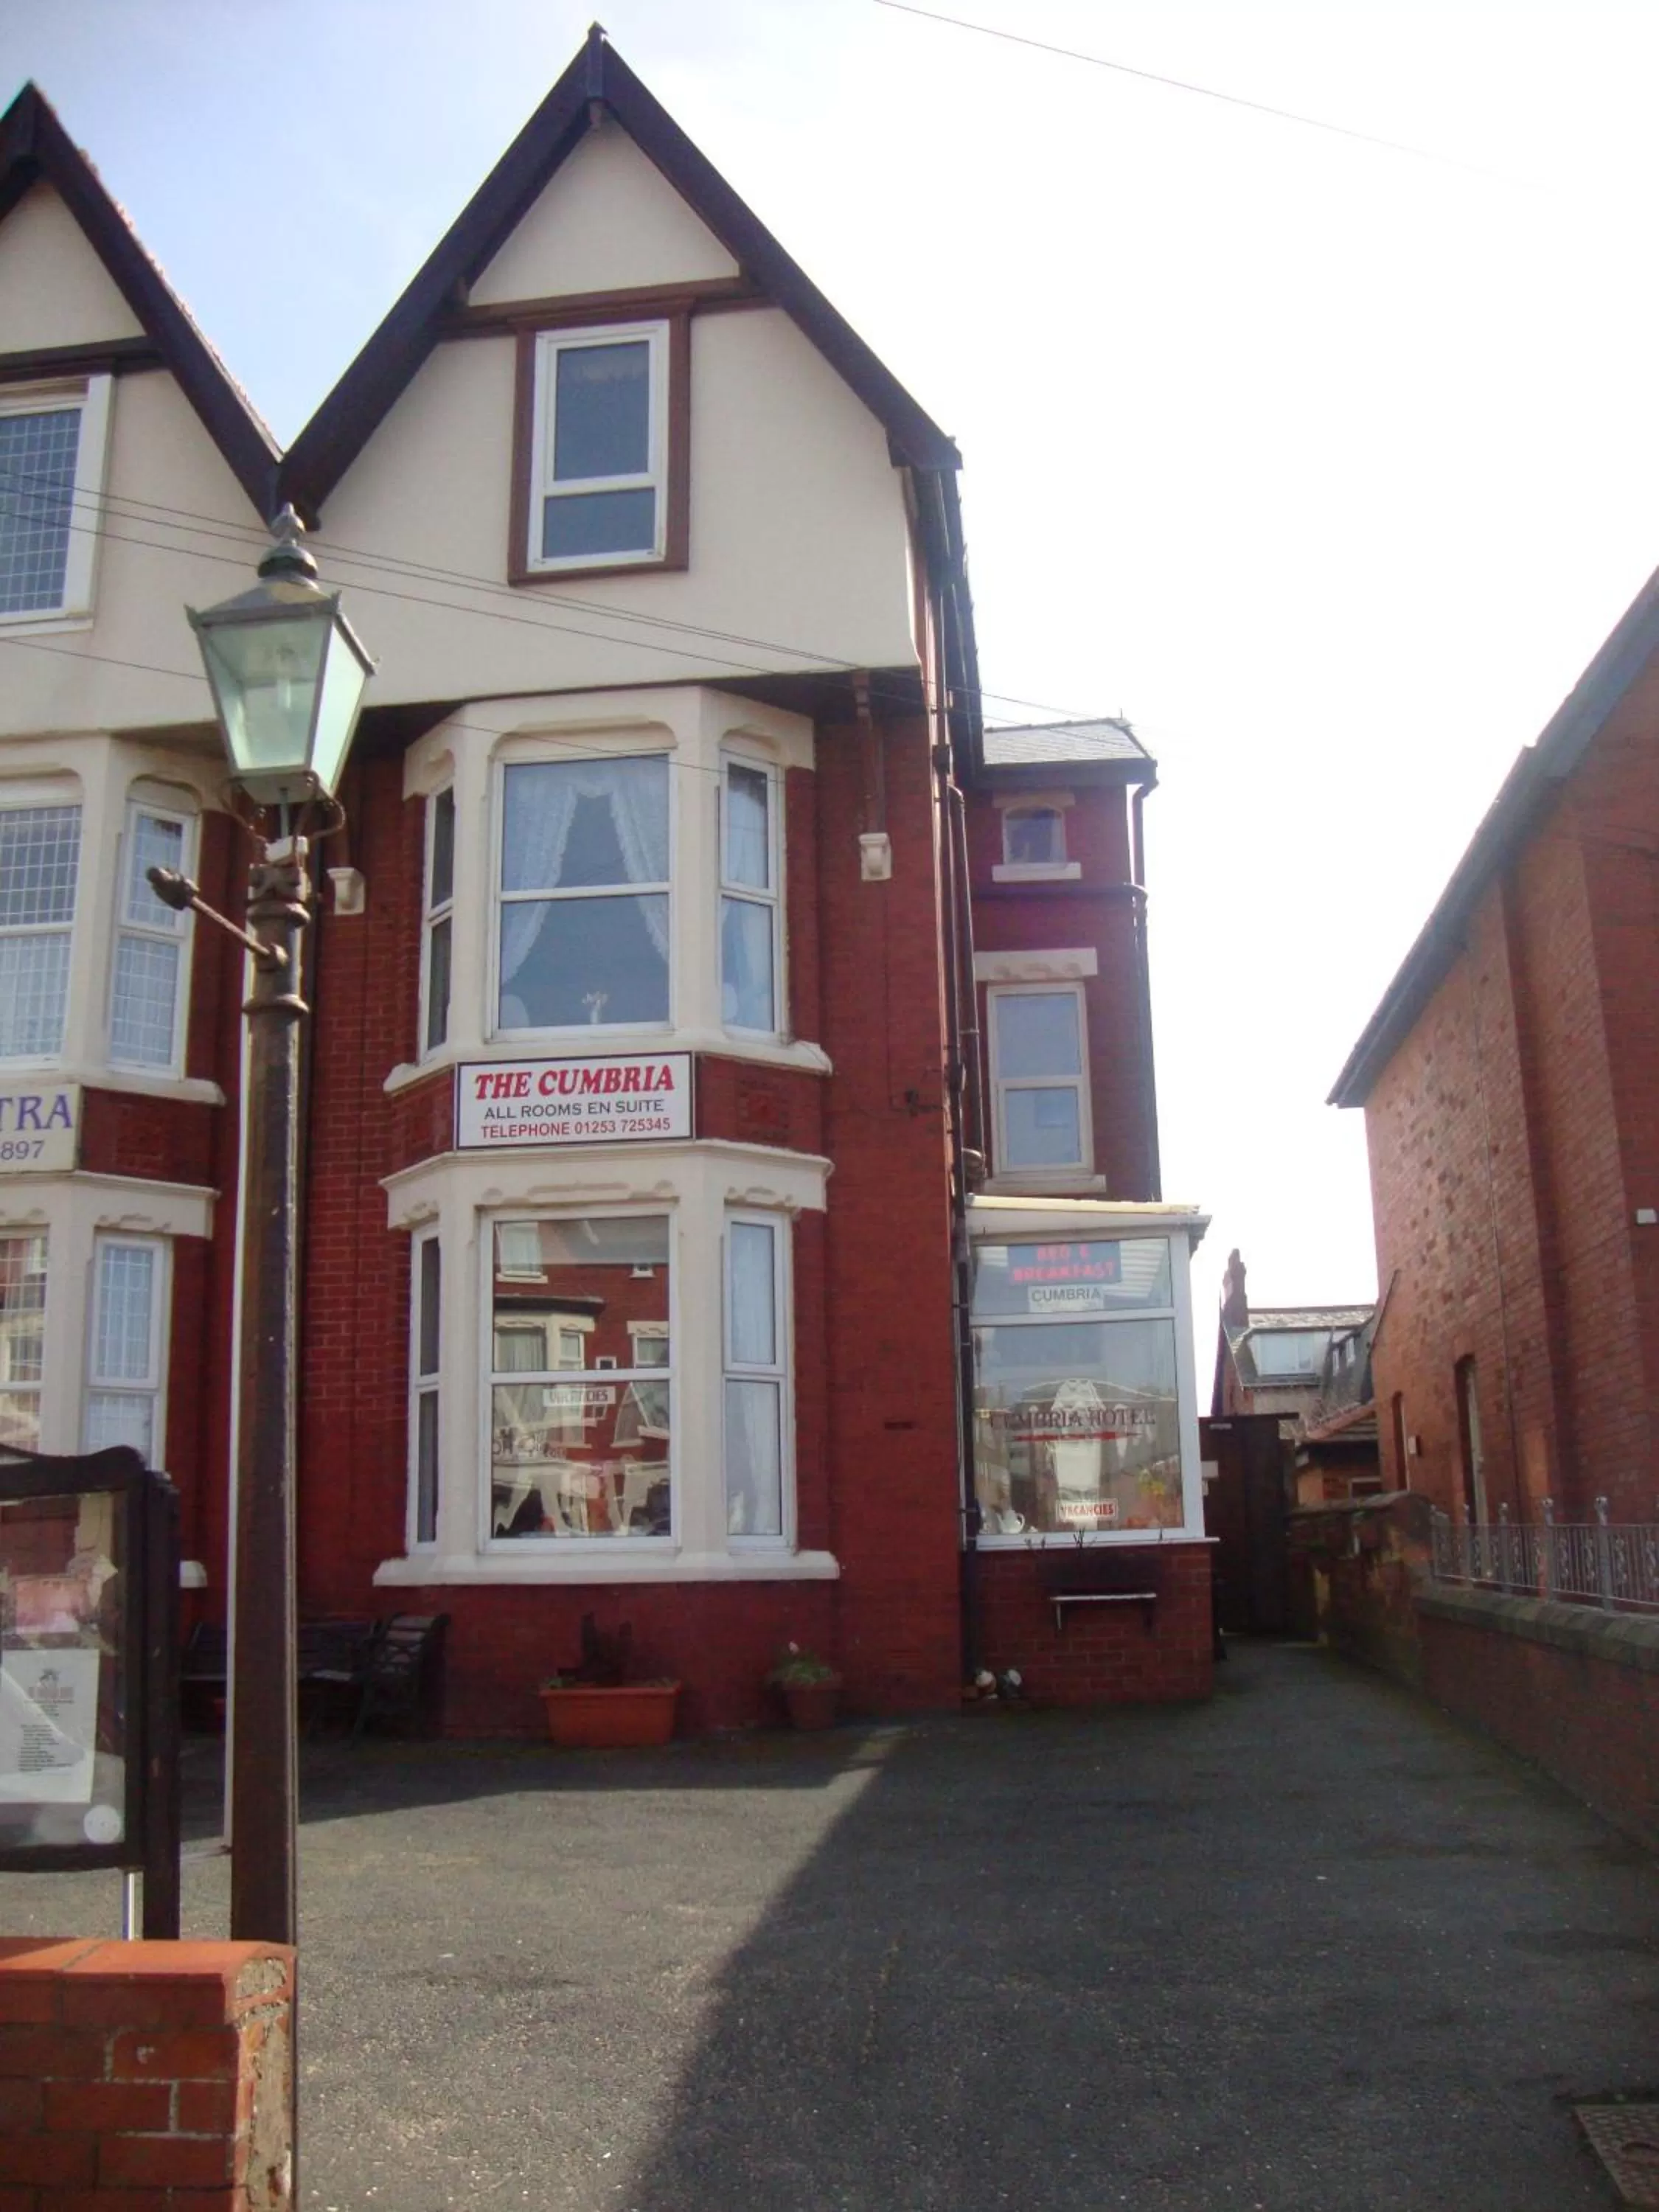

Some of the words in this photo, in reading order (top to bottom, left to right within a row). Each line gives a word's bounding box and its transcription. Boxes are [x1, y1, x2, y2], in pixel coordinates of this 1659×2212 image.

[475, 1071, 533, 1099] THE
[538, 1065, 675, 1096] CUMBRIA
[484, 1106, 517, 1119] ALL
[521, 1102, 582, 1118] ROOMS
[588, 1101, 611, 1114] EN
[616, 1099, 664, 1113] SUITE
[481, 1121, 570, 1139] TELEPHONE
[574, 1120, 616, 1135] 01253
[621, 1117, 670, 1133] 725345
[0, 1140, 45, 1161] 897
[1032, 1287, 1102, 1302] CUMBRIA
